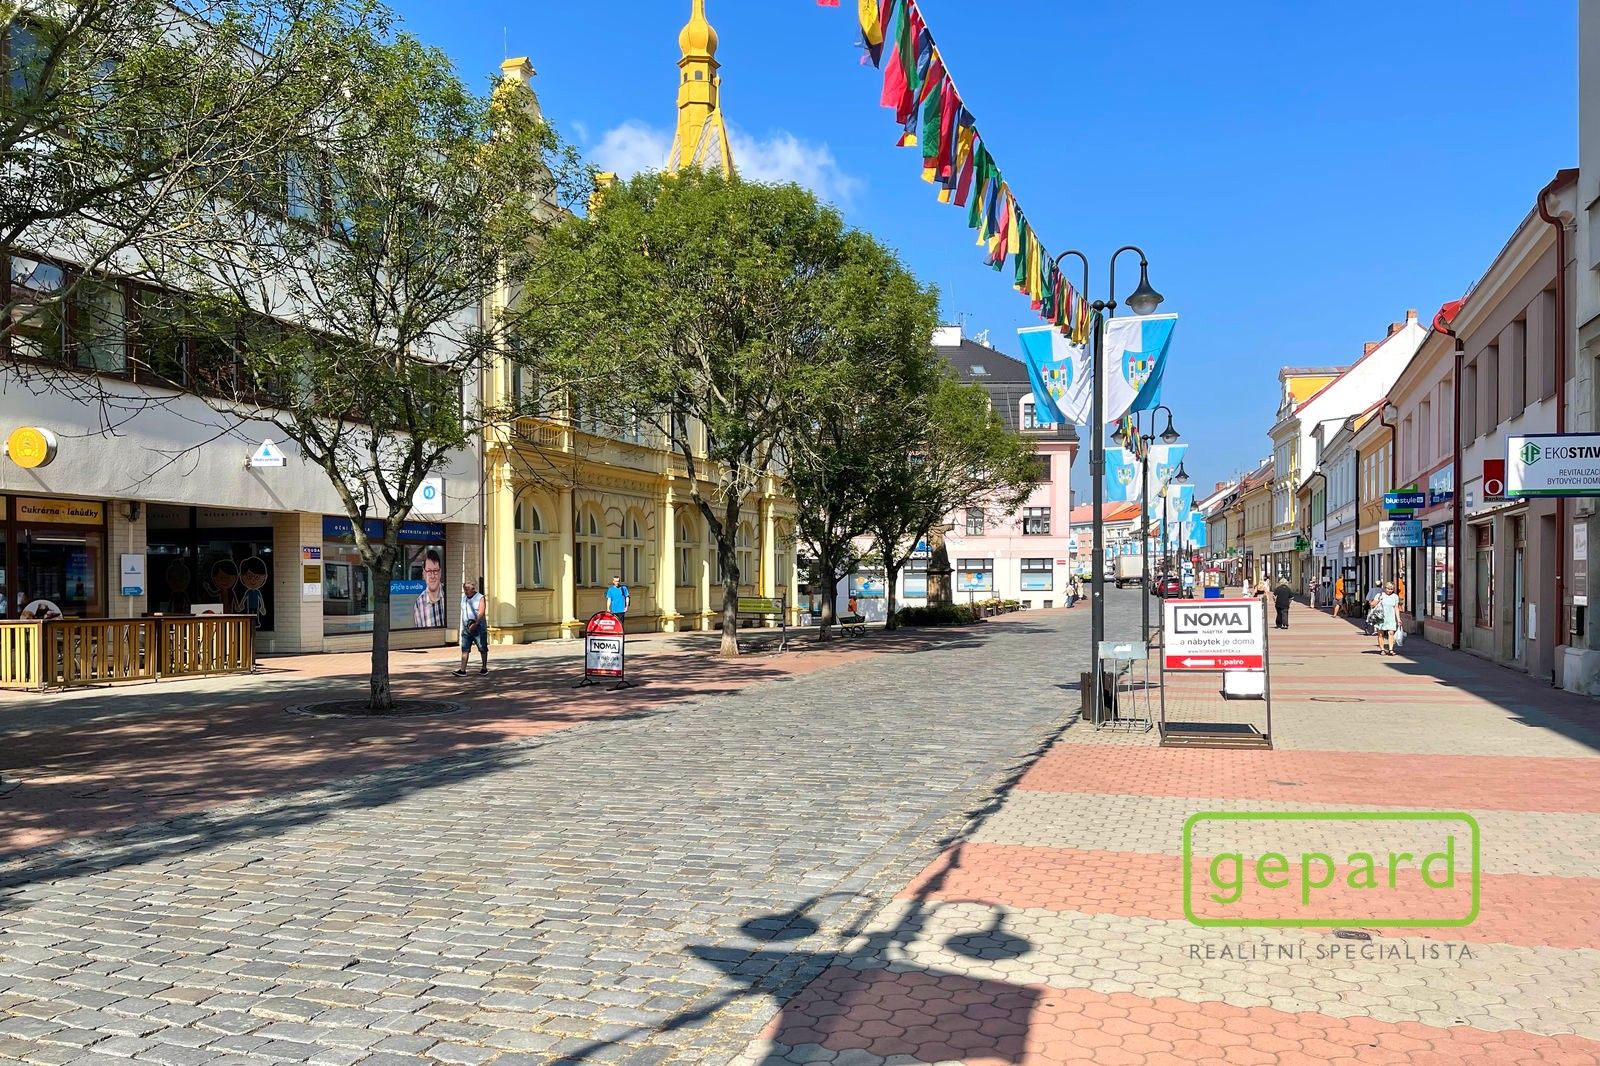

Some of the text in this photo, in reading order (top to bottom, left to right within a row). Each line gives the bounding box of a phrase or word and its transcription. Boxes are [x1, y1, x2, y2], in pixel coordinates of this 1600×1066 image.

[1559, 468, 1600, 476] REVITALIZAC
[1547, 476, 1581, 485] BYTOVÝCH
[1385, 496, 1417, 505] bluestyle
[21, 505, 60, 515] Cukrárna
[1184, 613, 1242, 626] NOMA
[593, 642, 617, 650] NOMA
[1187, 637, 1221, 647] nábytek
[1222, 638, 1230, 647] je
[1232, 637, 1255, 645] doma
[1217, 657, 1244, 667] 1.patro
